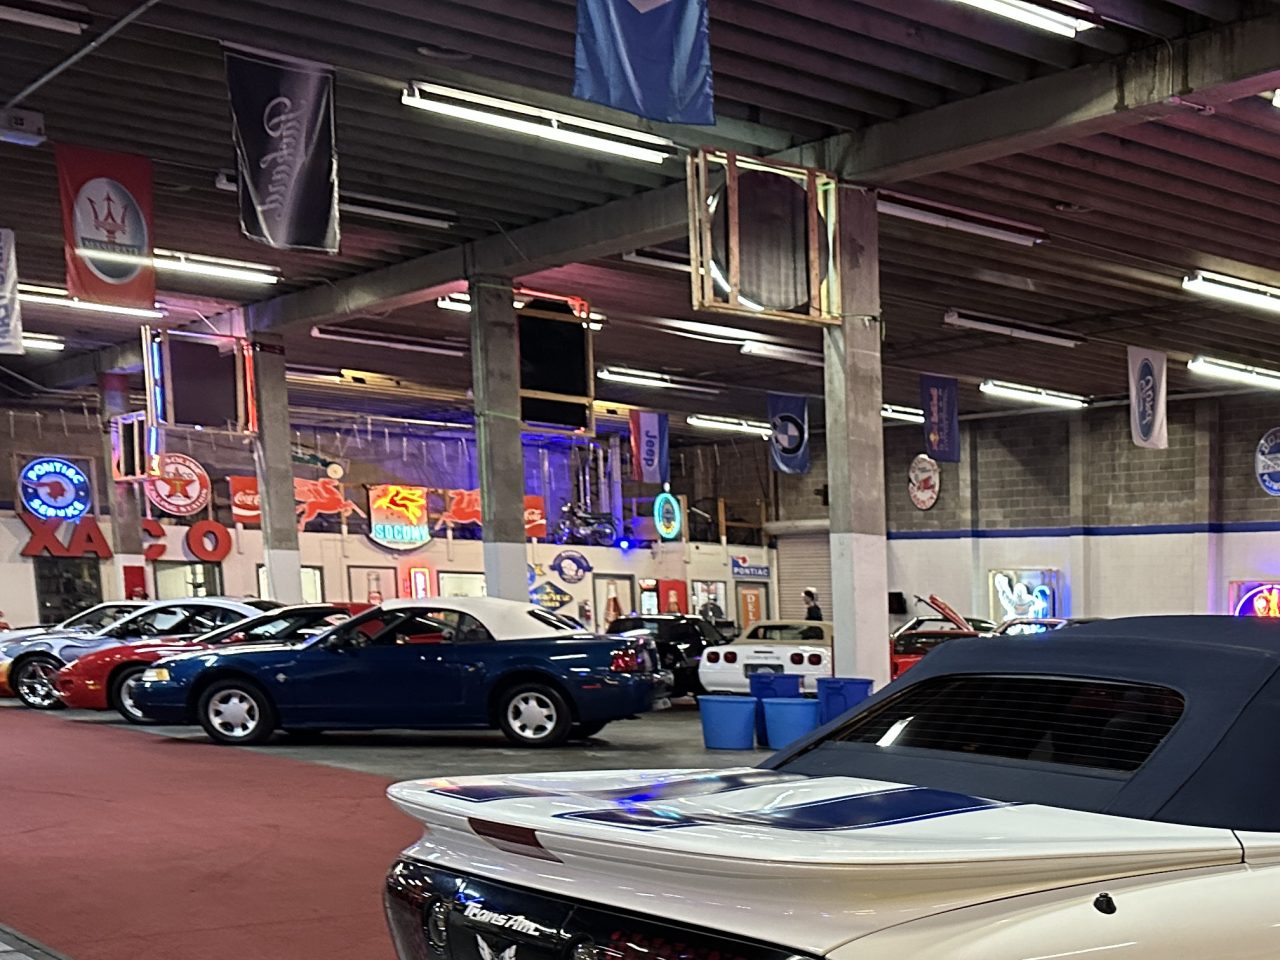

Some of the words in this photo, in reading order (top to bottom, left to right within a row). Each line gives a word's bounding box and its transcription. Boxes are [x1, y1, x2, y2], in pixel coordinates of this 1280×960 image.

[643, 430, 658, 467] Jeep
[27, 462, 84, 484] PONTIAC
[28, 498, 85, 518] SERVICE
[373, 523, 428, 541] SOCONY
[733, 567, 769, 576] PONTIAC
[463, 902, 509, 927] Trans
